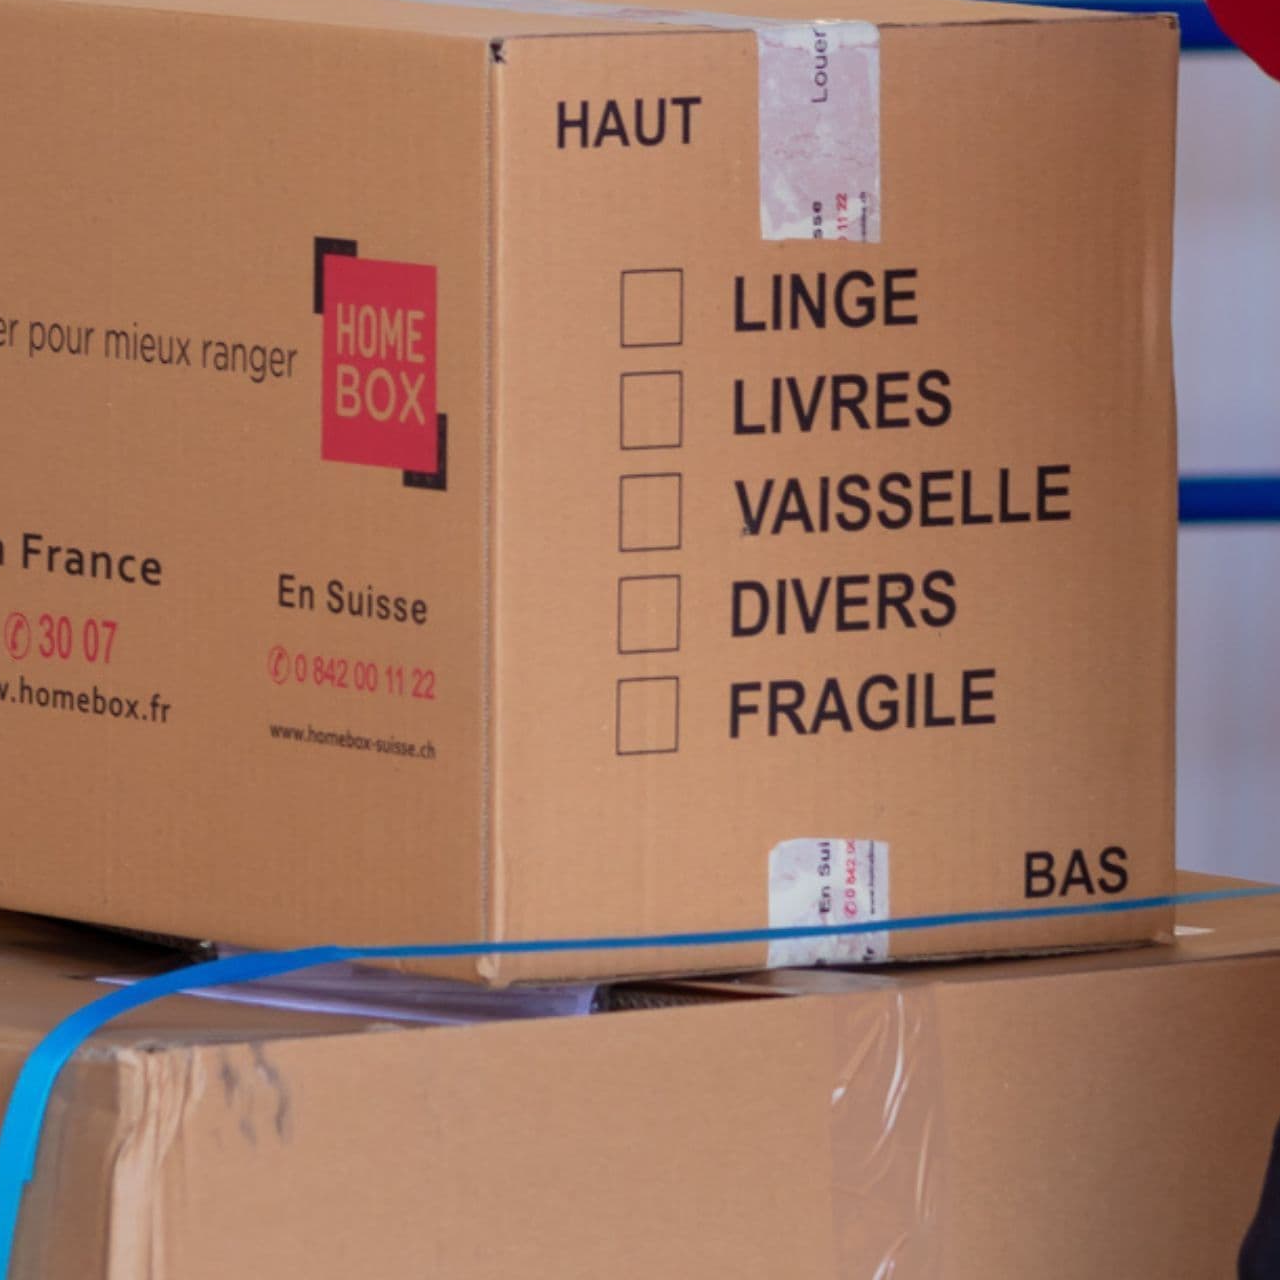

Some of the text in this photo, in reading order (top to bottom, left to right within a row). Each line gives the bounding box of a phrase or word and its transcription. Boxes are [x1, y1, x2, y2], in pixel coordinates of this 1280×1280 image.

[556, 96, 702, 149] HAUT
[733, 268, 919, 333] LINGE
[29, 319, 94, 357] pour
[104, 321, 191, 368] mieux
[201, 338, 298, 383] ranger
[336, 303, 425, 363] HOME
[336, 367, 426, 425] BOX
[733, 369, 953, 436] LIVRES
[734, 464, 1071, 537] VAISSELLE
[22, 533, 162, 586] France
[278, 573, 429, 625] En Suisse
[730, 570, 957, 638] DIVERS
[38, 613, 118, 664] 30 07
[313, 655, 348, 688] 842
[354, 661, 378, 692] 00
[386, 665, 404, 695] 11
[412, 668, 435, 699] 22
[729, 668, 996, 739] FRAGILE
[1024, 846, 1129, 899] BAS
